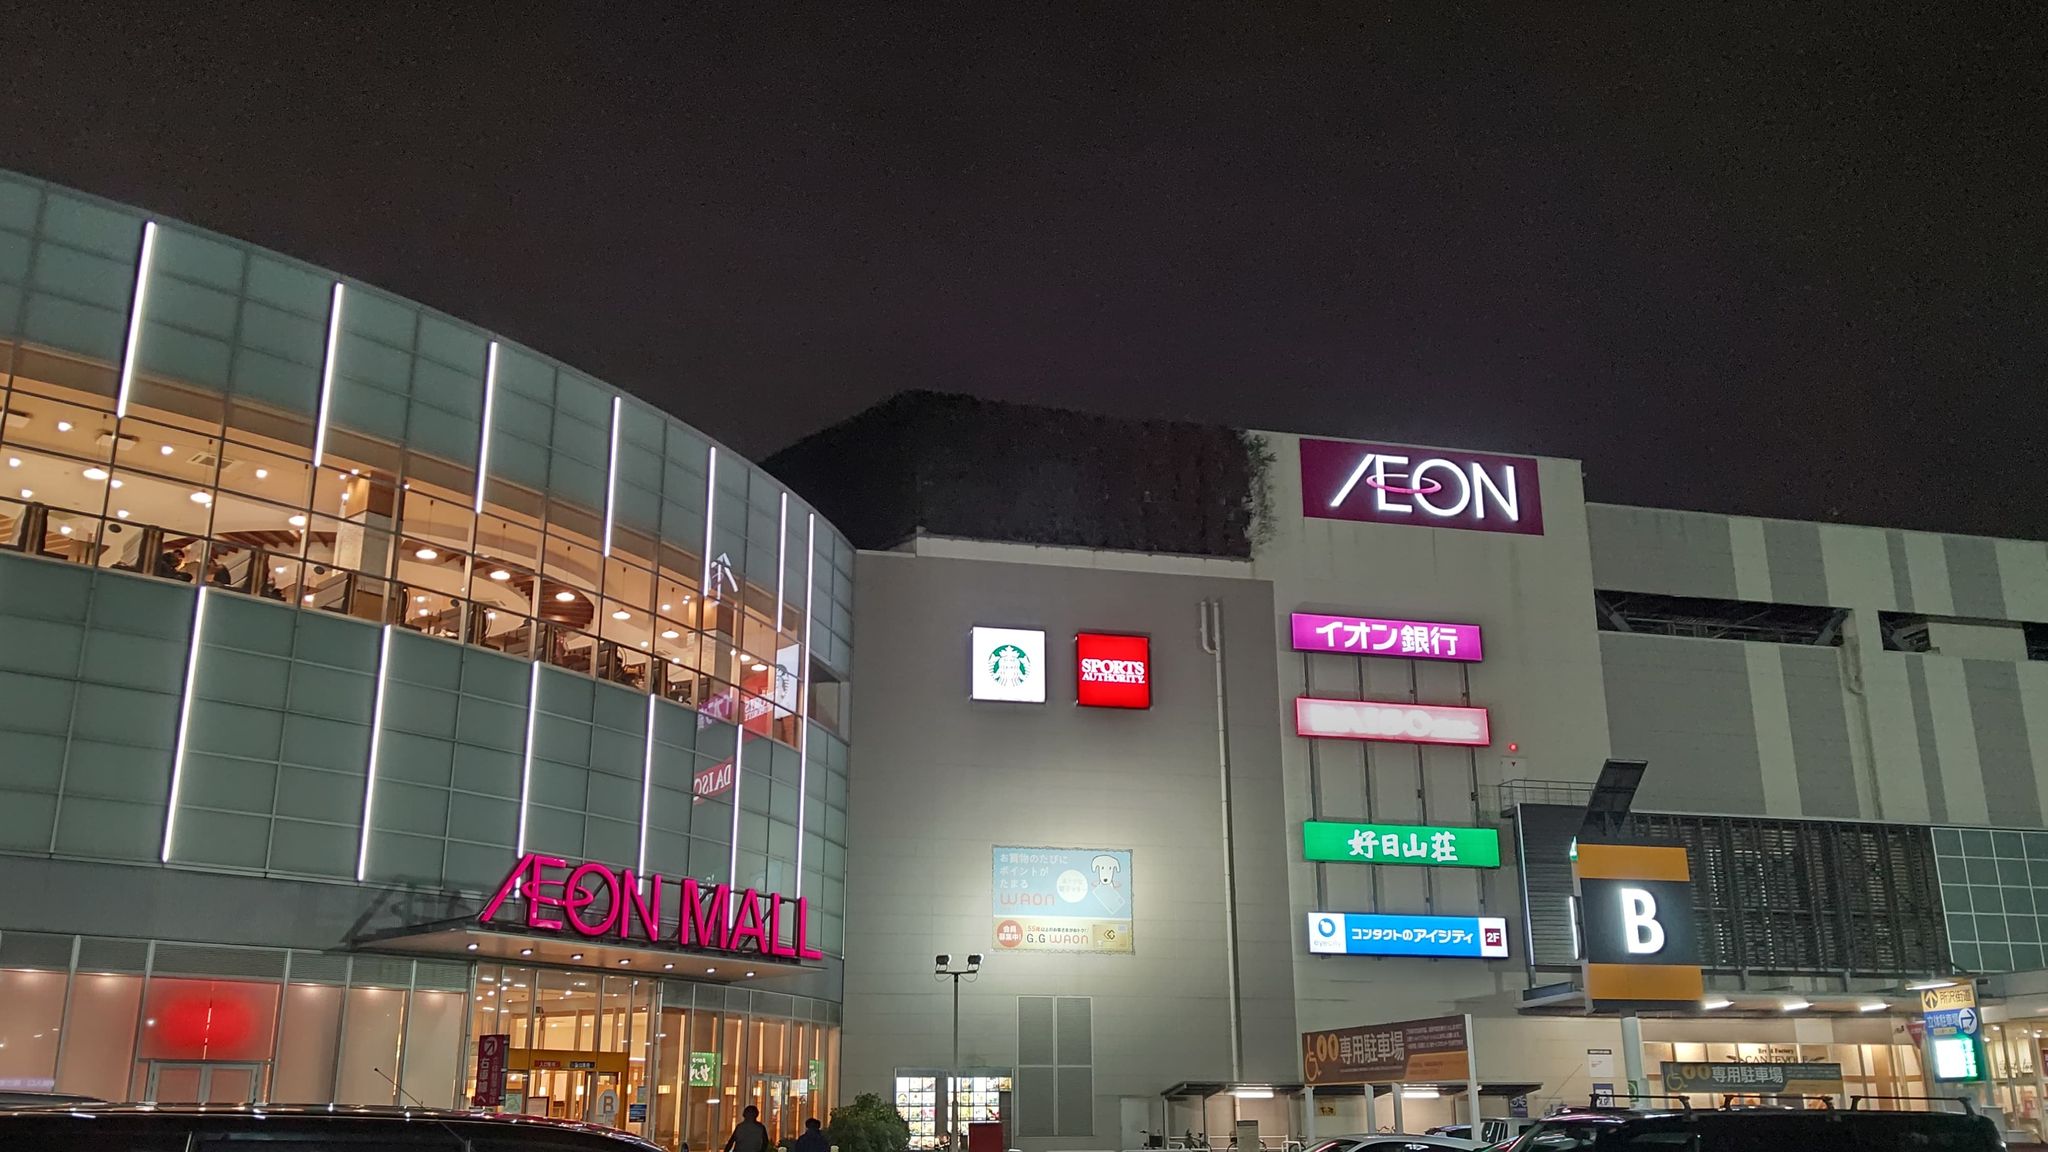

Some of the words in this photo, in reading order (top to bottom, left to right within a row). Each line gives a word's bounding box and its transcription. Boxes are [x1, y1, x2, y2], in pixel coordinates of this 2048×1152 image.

[1315, 621, 1459, 656] イオン銀行
[1081, 658, 1144, 675] SPORTS
[1082, 672, 1145, 684] AUTHORITY
[1347, 829, 1458, 862] 好日山荘
[999, 853, 1069, 865] お買物のたびに
[999, 866, 1049, 877] ポイントが
[999, 878, 1029, 889] たまる
[678, 878, 822, 961] MALL
[1621, 887, 1665, 954] B
[1026, 933, 1046, 944] G.G
[1351, 928, 1473, 944] コンタクトのアイシティ
[1486, 932, 1501, 943] 2F
[1339, 1031, 1405, 1065] 専用駐車場
[1712, 1066, 1784, 1084] 専用駐車場
[603, 1096, 614, 1114] B
